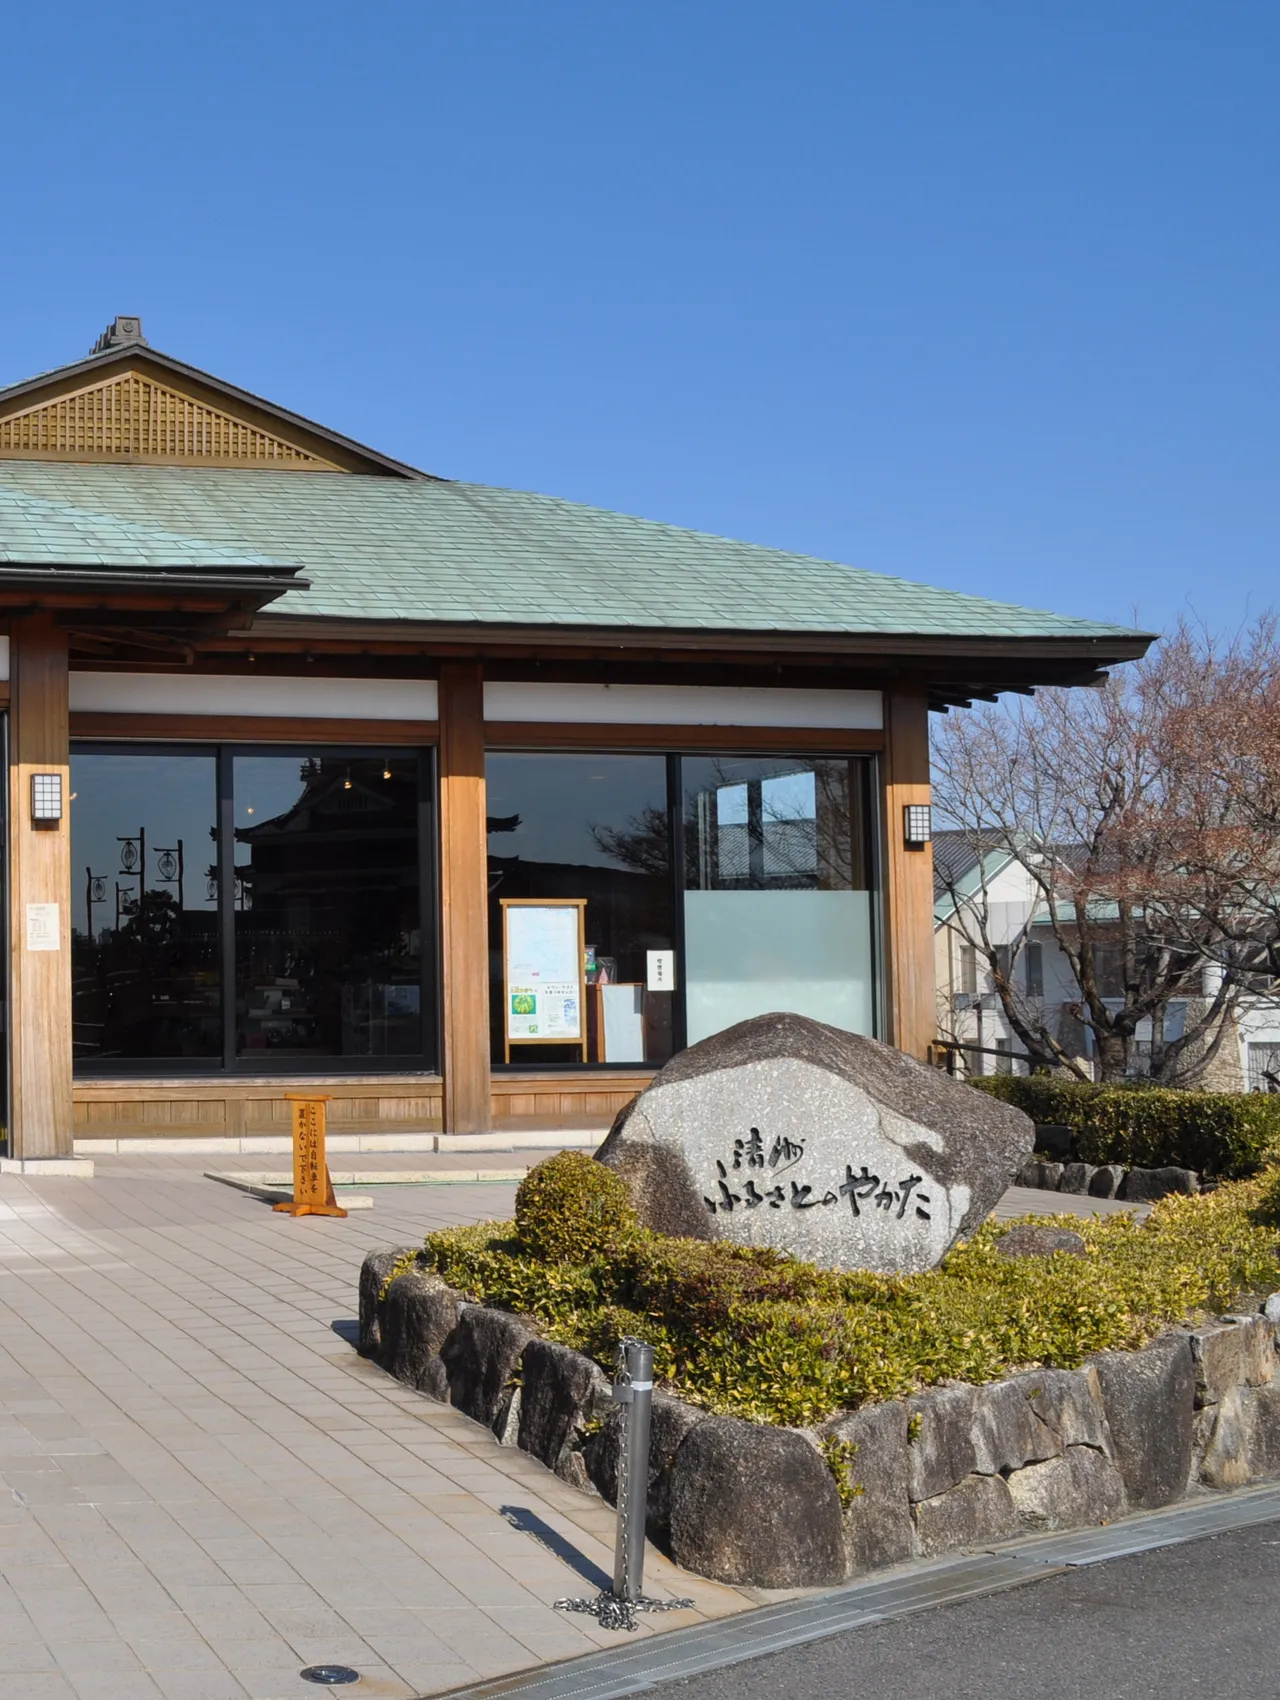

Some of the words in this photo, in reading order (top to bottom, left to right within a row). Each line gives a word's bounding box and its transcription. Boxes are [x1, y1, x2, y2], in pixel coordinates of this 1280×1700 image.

[703, 1159, 932, 1221] ふるさとのやかた
